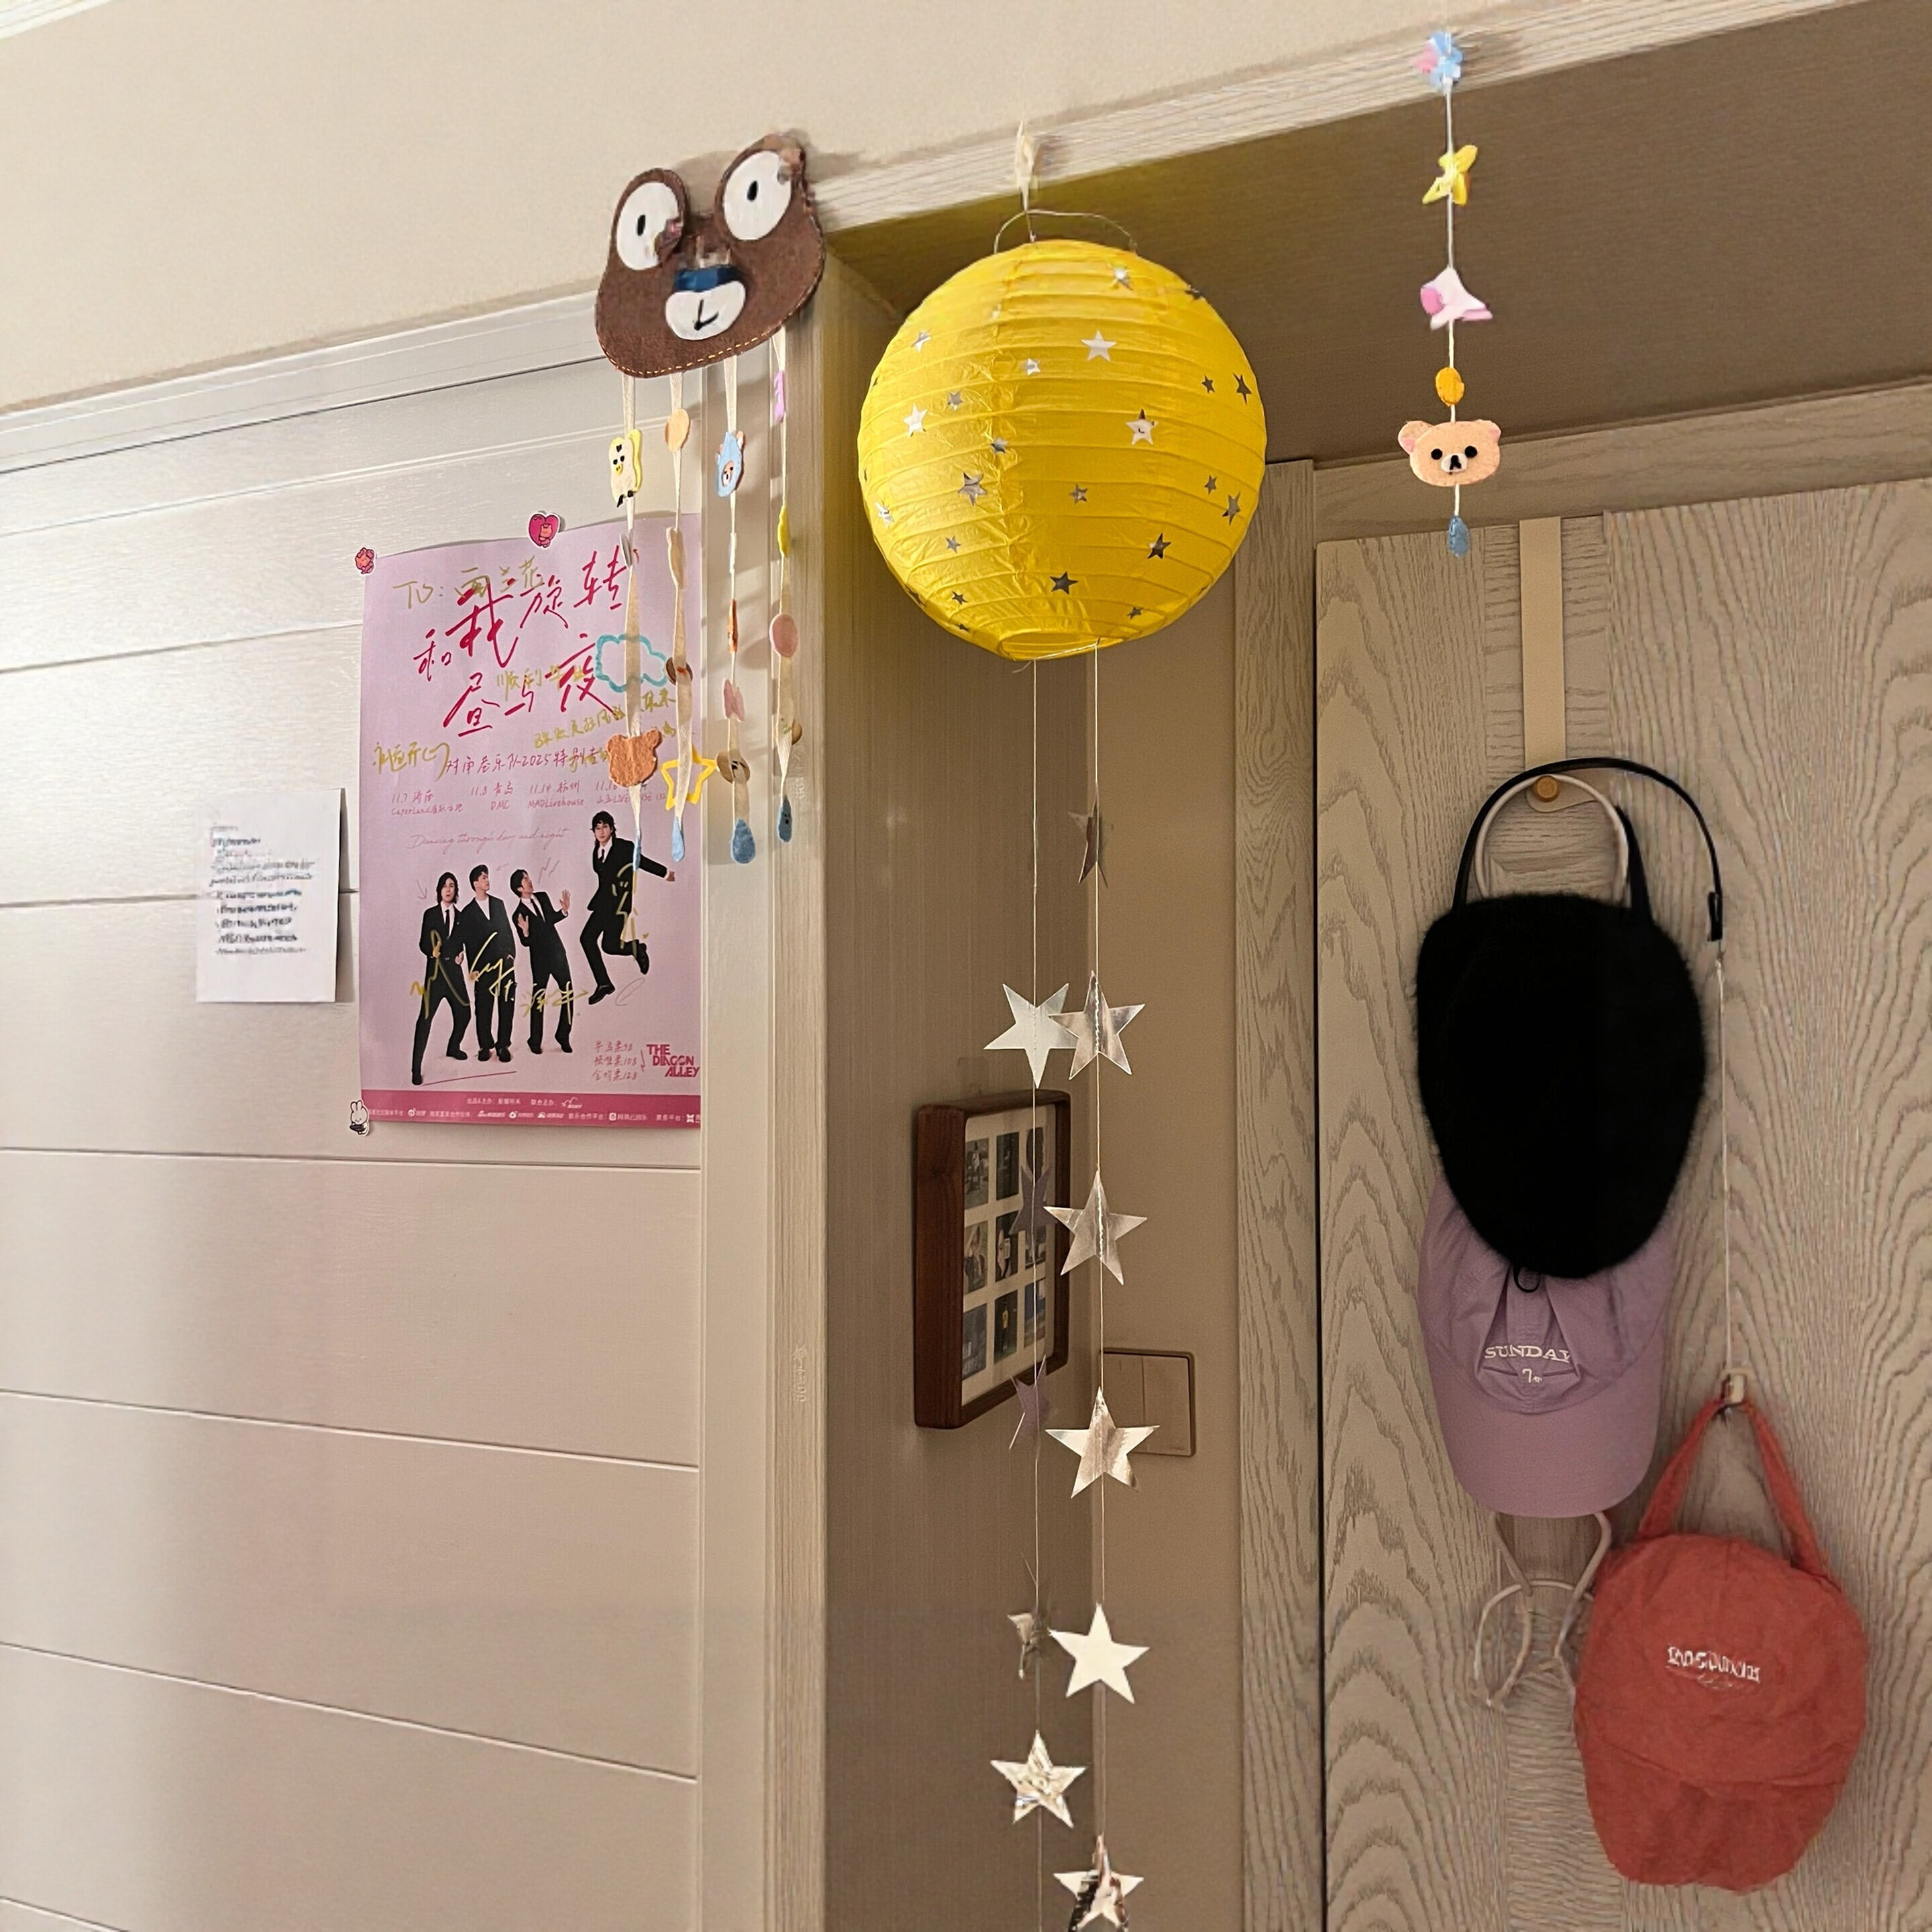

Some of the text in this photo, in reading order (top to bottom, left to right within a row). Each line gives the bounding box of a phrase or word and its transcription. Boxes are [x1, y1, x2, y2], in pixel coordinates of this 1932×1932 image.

[647, 1044, 671, 1055] THE
[653, 1055, 694, 1066] DIAGON
[665, 1067, 700, 1077] ALLEY
[1484, 1344, 1571, 1363] SUNDAY
